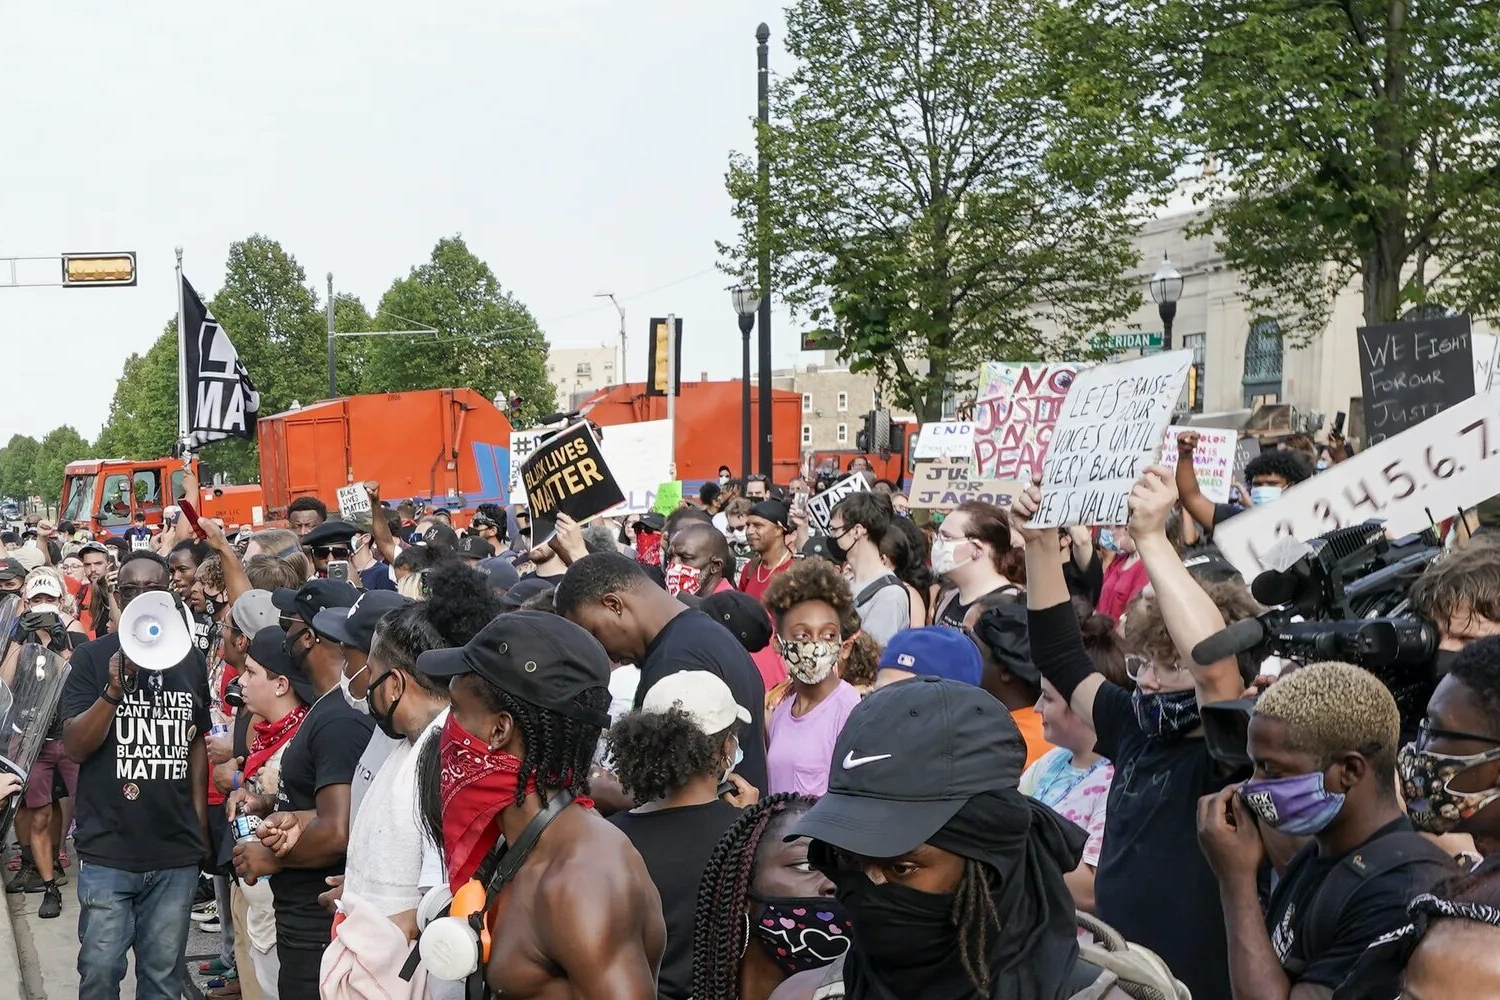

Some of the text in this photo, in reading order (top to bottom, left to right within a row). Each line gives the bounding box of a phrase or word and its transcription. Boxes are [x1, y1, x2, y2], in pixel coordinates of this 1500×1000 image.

[1362, 331, 1468, 367] WE FIGHT
[1013, 365, 1077, 395] NO
[1069, 374, 1173, 419] LET'S RAISE
[1122, 398, 1156, 421] OUR
[975, 396, 1066, 436] JUSTI
[1372, 399, 1444, 428] JUSTI
[932, 424, 971, 436] END
[1053, 421, 1156, 454] VOICES UNTIL
[1199, 433, 1227, 444] OLOR
[524, 456, 548, 491] BLACK
[544, 436, 589, 472] LIVES
[1040, 454, 1140, 488] EVERY BLACK
[342, 494, 359, 506] LIVES
[529, 456, 605, 520] MATTER
[918, 491, 1013, 507] JACOB
[343, 499, 370, 516] MATTER
[1032, 488, 1133, 529] IFE IS VALUE
[116, 704, 193, 721] CANT MATTER
[154, 690, 193, 709] LIVES
[115, 717, 189, 747] UNTIL
[116, 745, 189, 760] BLACK LIVES
[116, 758, 188, 780] MATTER
